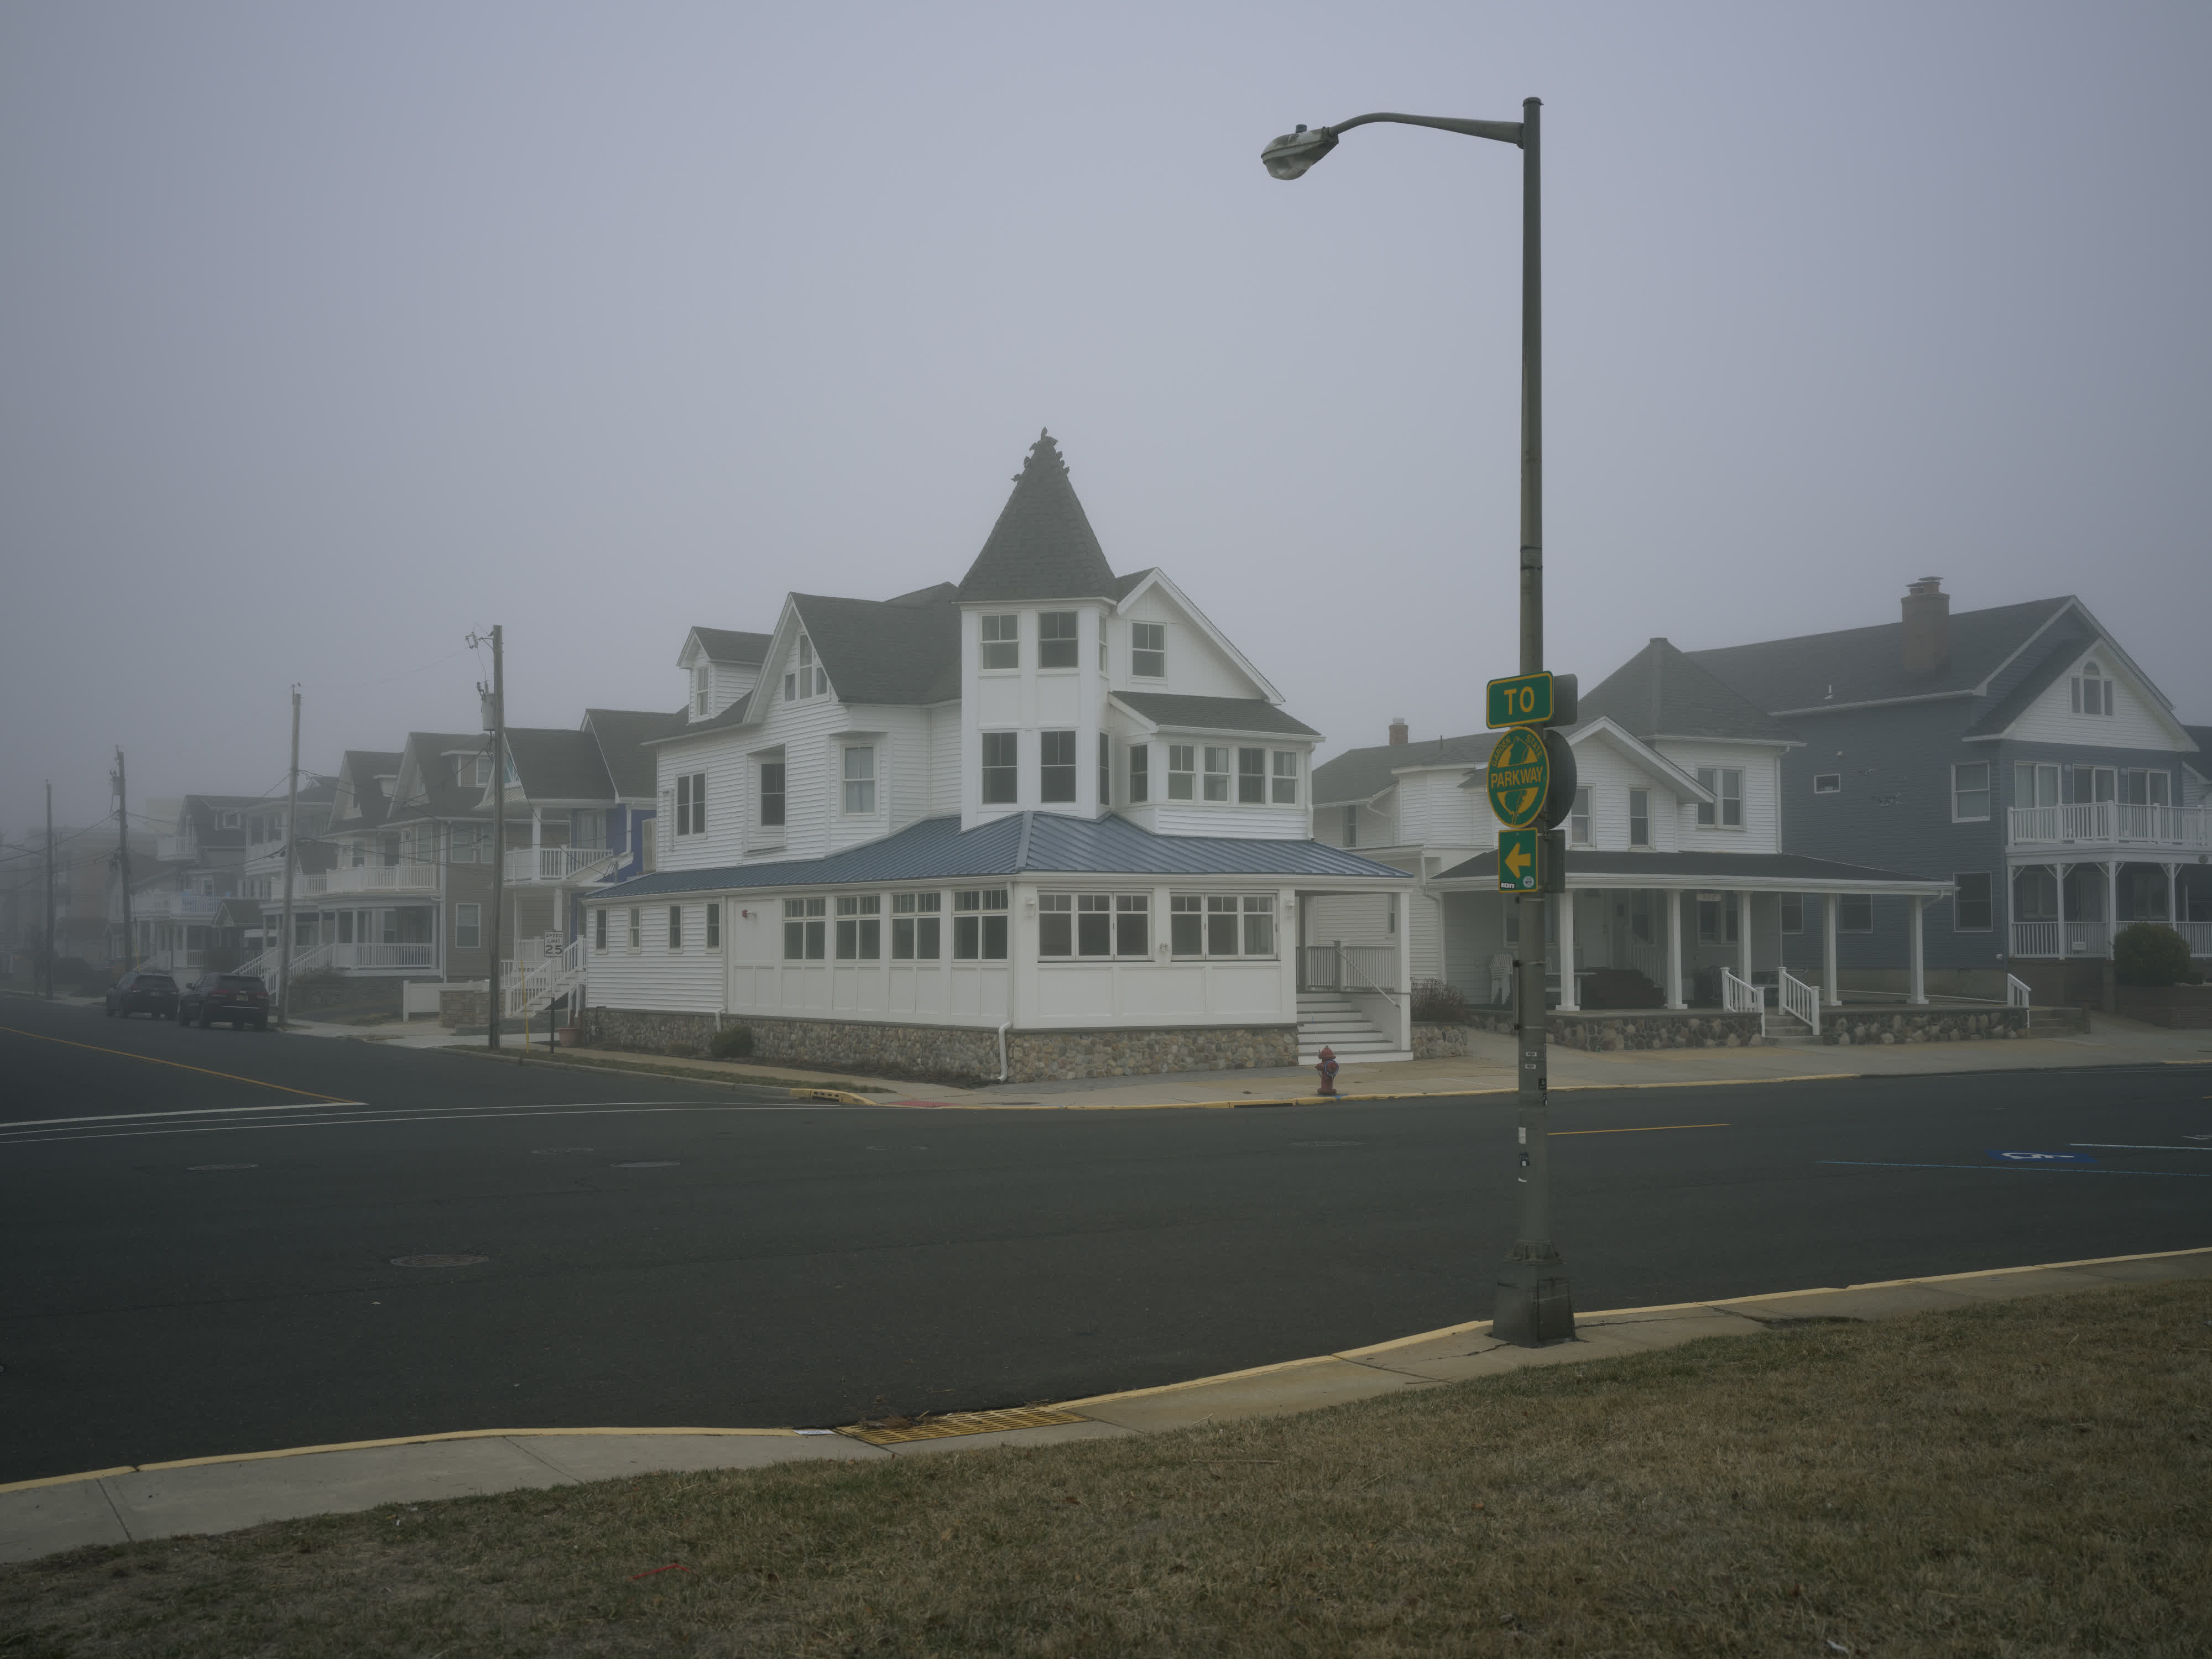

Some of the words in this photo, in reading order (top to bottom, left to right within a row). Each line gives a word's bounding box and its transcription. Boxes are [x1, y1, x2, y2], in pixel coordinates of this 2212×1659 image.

[1504, 686, 1535, 716] TO
[1491, 736, 1511, 767] GARDEN
[1526, 734, 1543, 758] STATE
[1491, 765, 1543, 788] PARKWAY
[545, 945, 562, 954] 25
